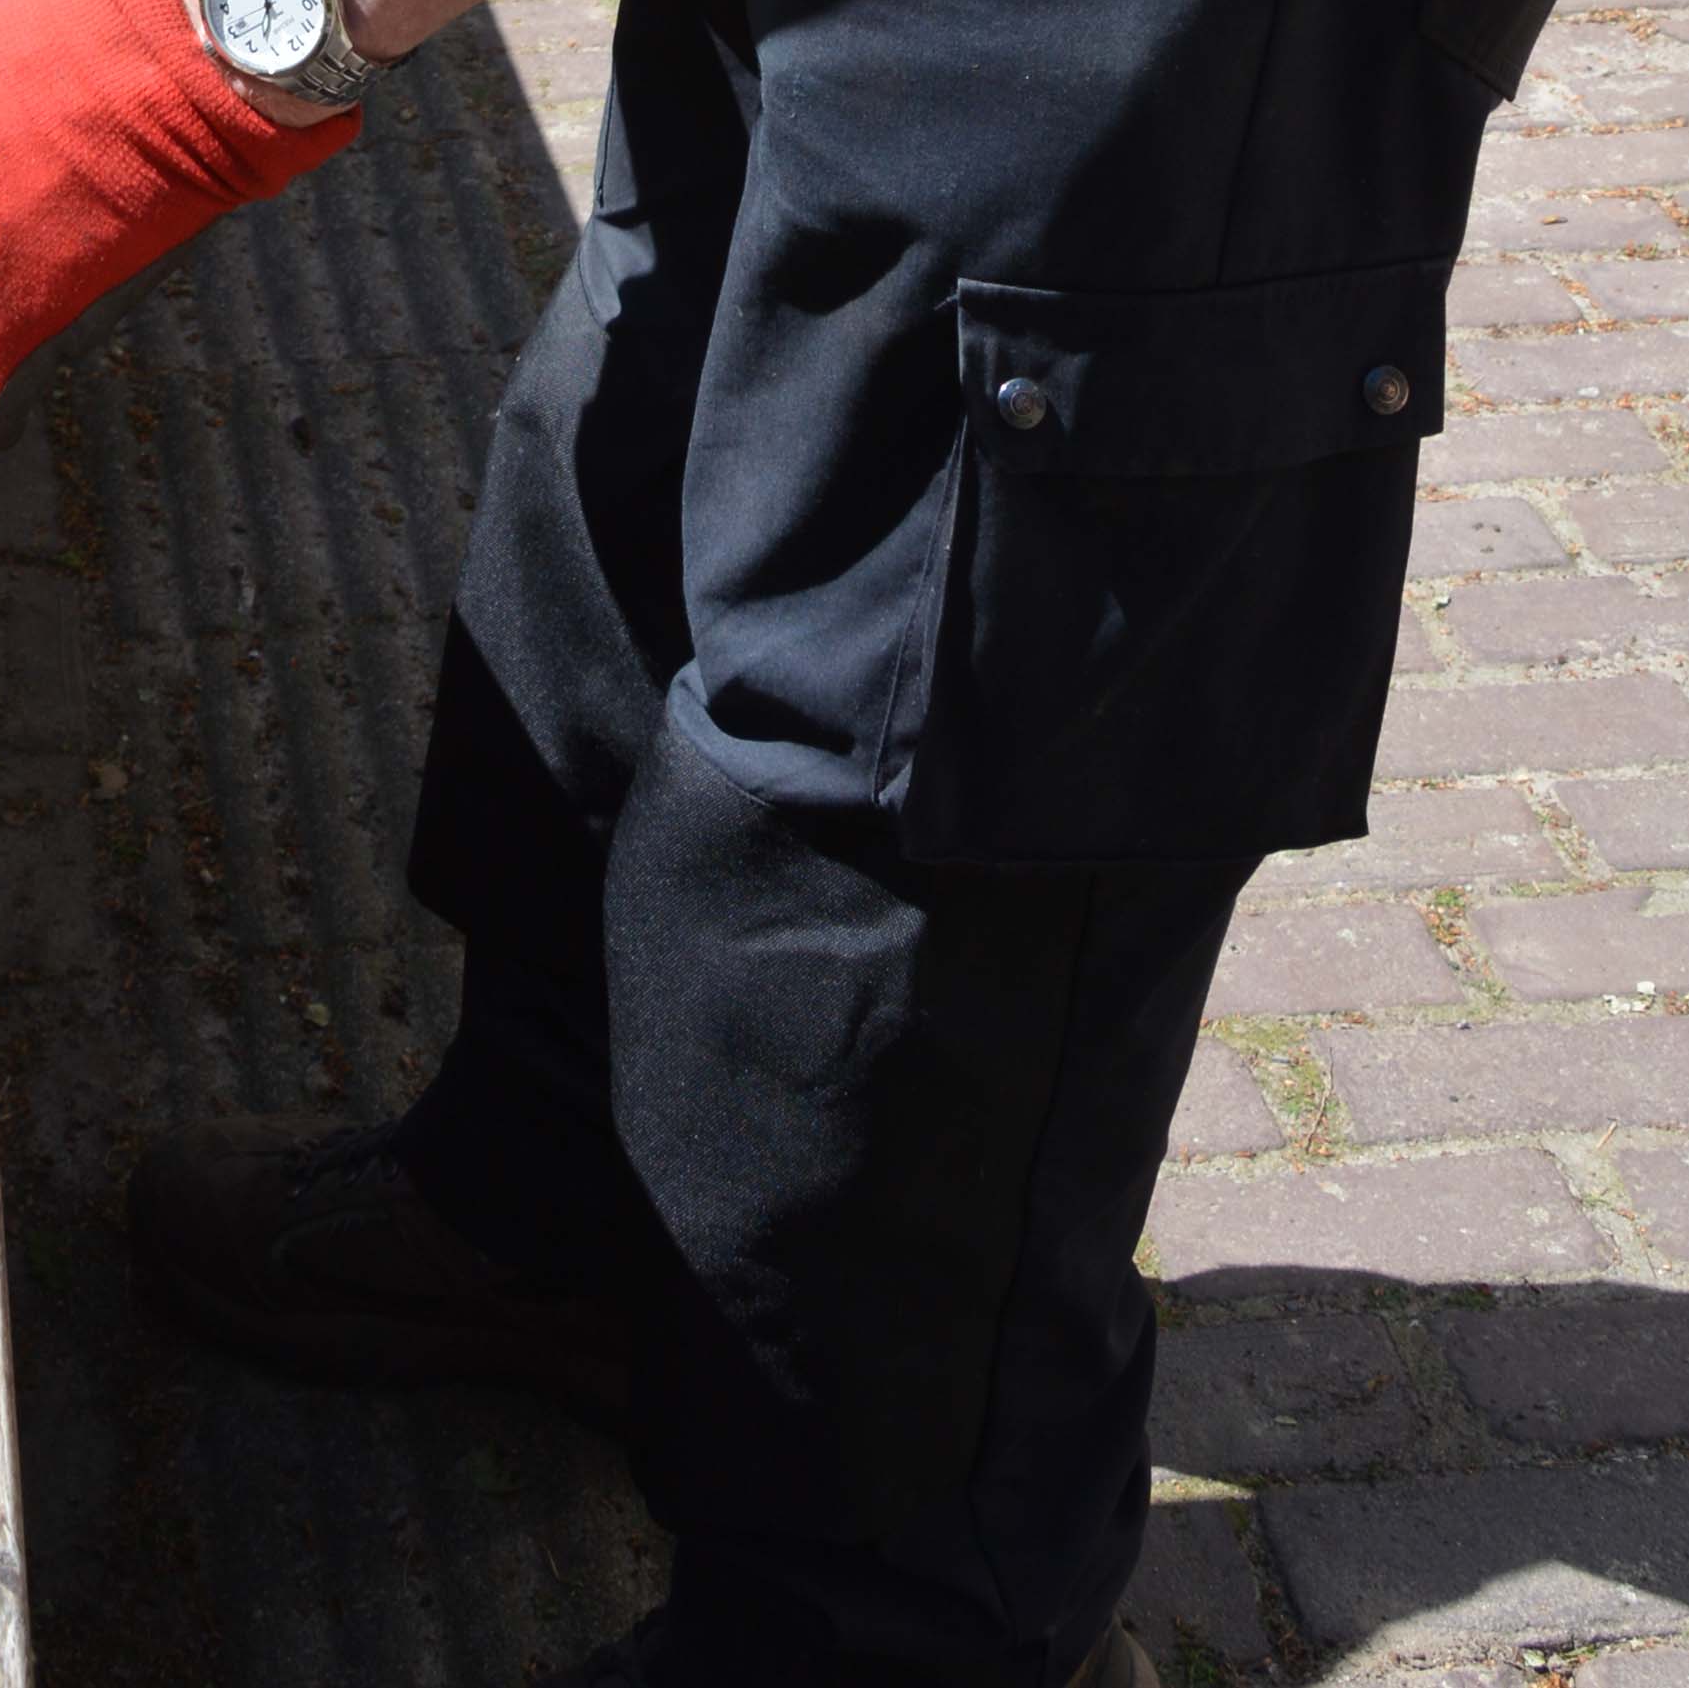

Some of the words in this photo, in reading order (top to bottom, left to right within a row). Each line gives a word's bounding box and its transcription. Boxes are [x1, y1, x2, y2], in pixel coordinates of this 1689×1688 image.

[219, 1, 231, 15] 4
[227, 26, 239, 41] 3
[302, 18, 316, 34] 11
[245, 39, 258, 54] 2
[288, 34, 305, 52] 12
